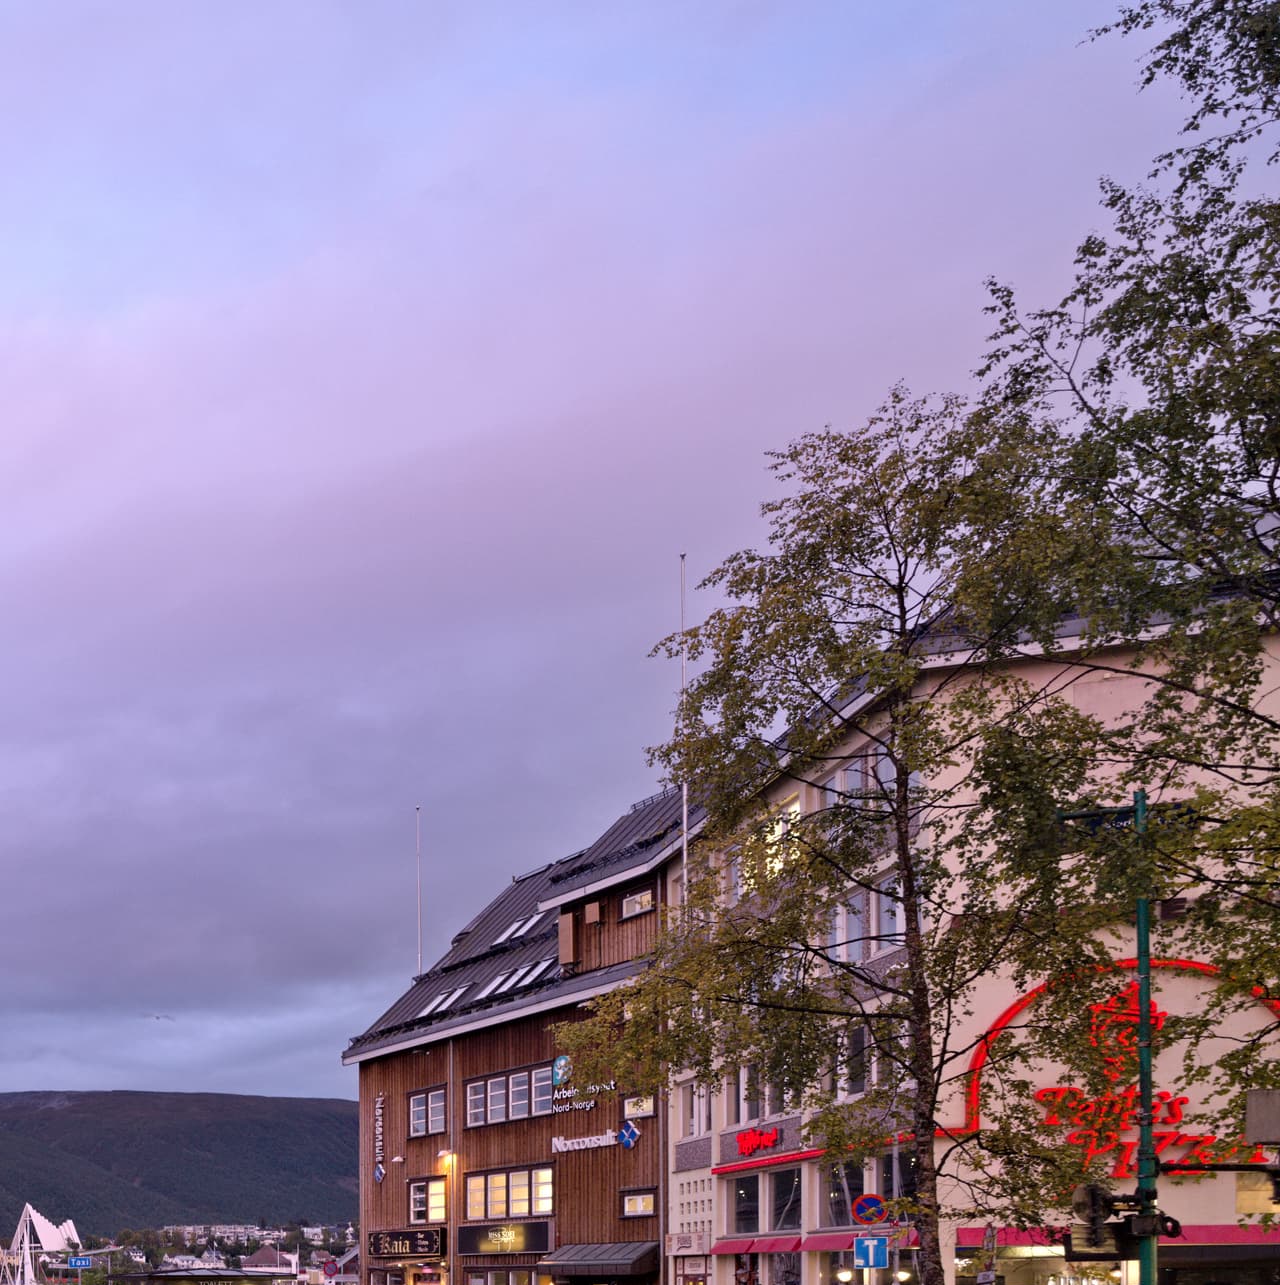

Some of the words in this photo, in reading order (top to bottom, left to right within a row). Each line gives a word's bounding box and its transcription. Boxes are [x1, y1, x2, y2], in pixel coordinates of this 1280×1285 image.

[552, 1100, 595, 1113] Nord-Norge
[375, 1097, 385, 1162] Norconsult
[552, 1129, 618, 1153] Norconsult
[378, 1234, 410, 1254] Kaia
[71, 1258, 89, 1266] Taxi
